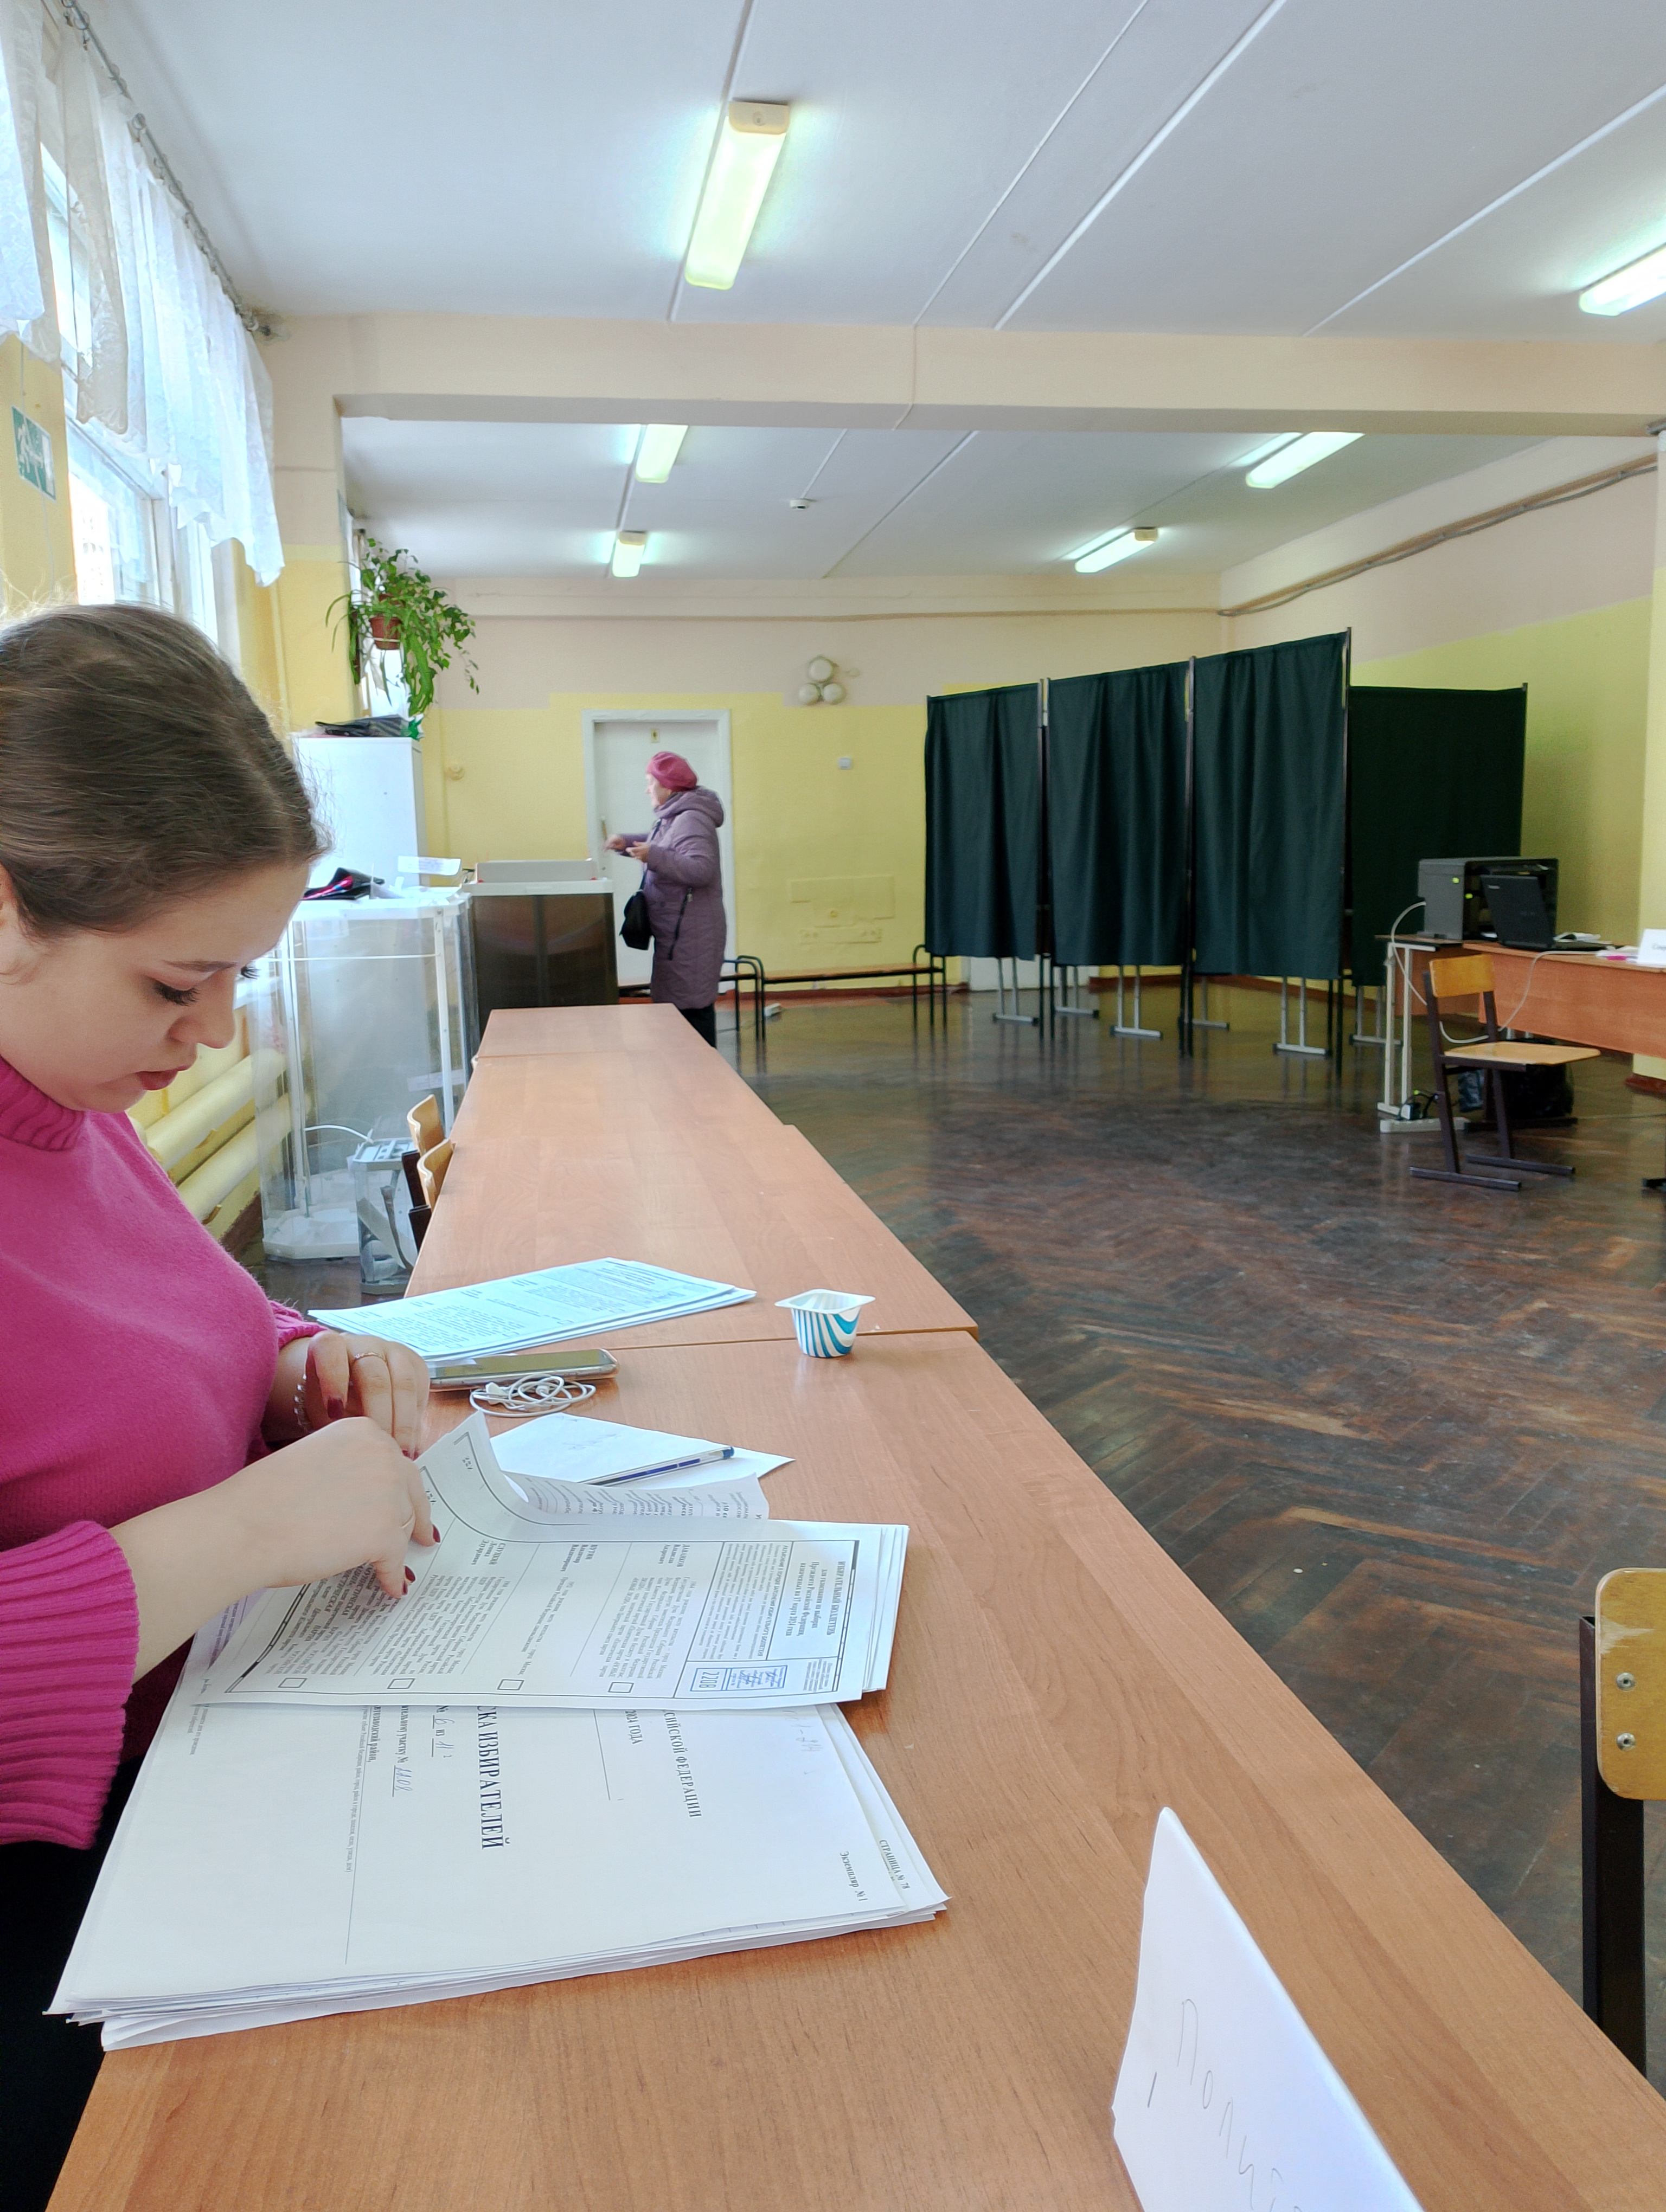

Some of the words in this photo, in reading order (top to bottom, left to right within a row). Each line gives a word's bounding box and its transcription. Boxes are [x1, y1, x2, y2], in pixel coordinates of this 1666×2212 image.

[488, 1543, 507, 1565] СЛУЦКИЙ
[585, 1544, 598, 1560] ПУТИН
[831, 1560, 847, 1603] ИЗБИРАТЕЛЬНЫЙ
[826, 1604, 840, 1636] БЮЛЛЕТЕНЬ
[699, 1671, 720, 1688] 2208
[371, 1706, 381, 1742] втозаводский
[477, 1706, 497, 1729] СКА
[664, 1710, 688, 1754] СИЙСКОЙ
[395, 1733, 408, 1755] участку
[627, 1725, 644, 1745] ГОДА
[366, 1743, 380, 1763] район,
[477, 1731, 511, 1850] ИЗБИРАТЕЛЕЙ
[675, 1756, 702, 1818] ФЕДЕРАЦИИ
[839, 1851, 860, 1887] Экземпляр
[879, 1840, 902, 1874] СТРАНИЦА
